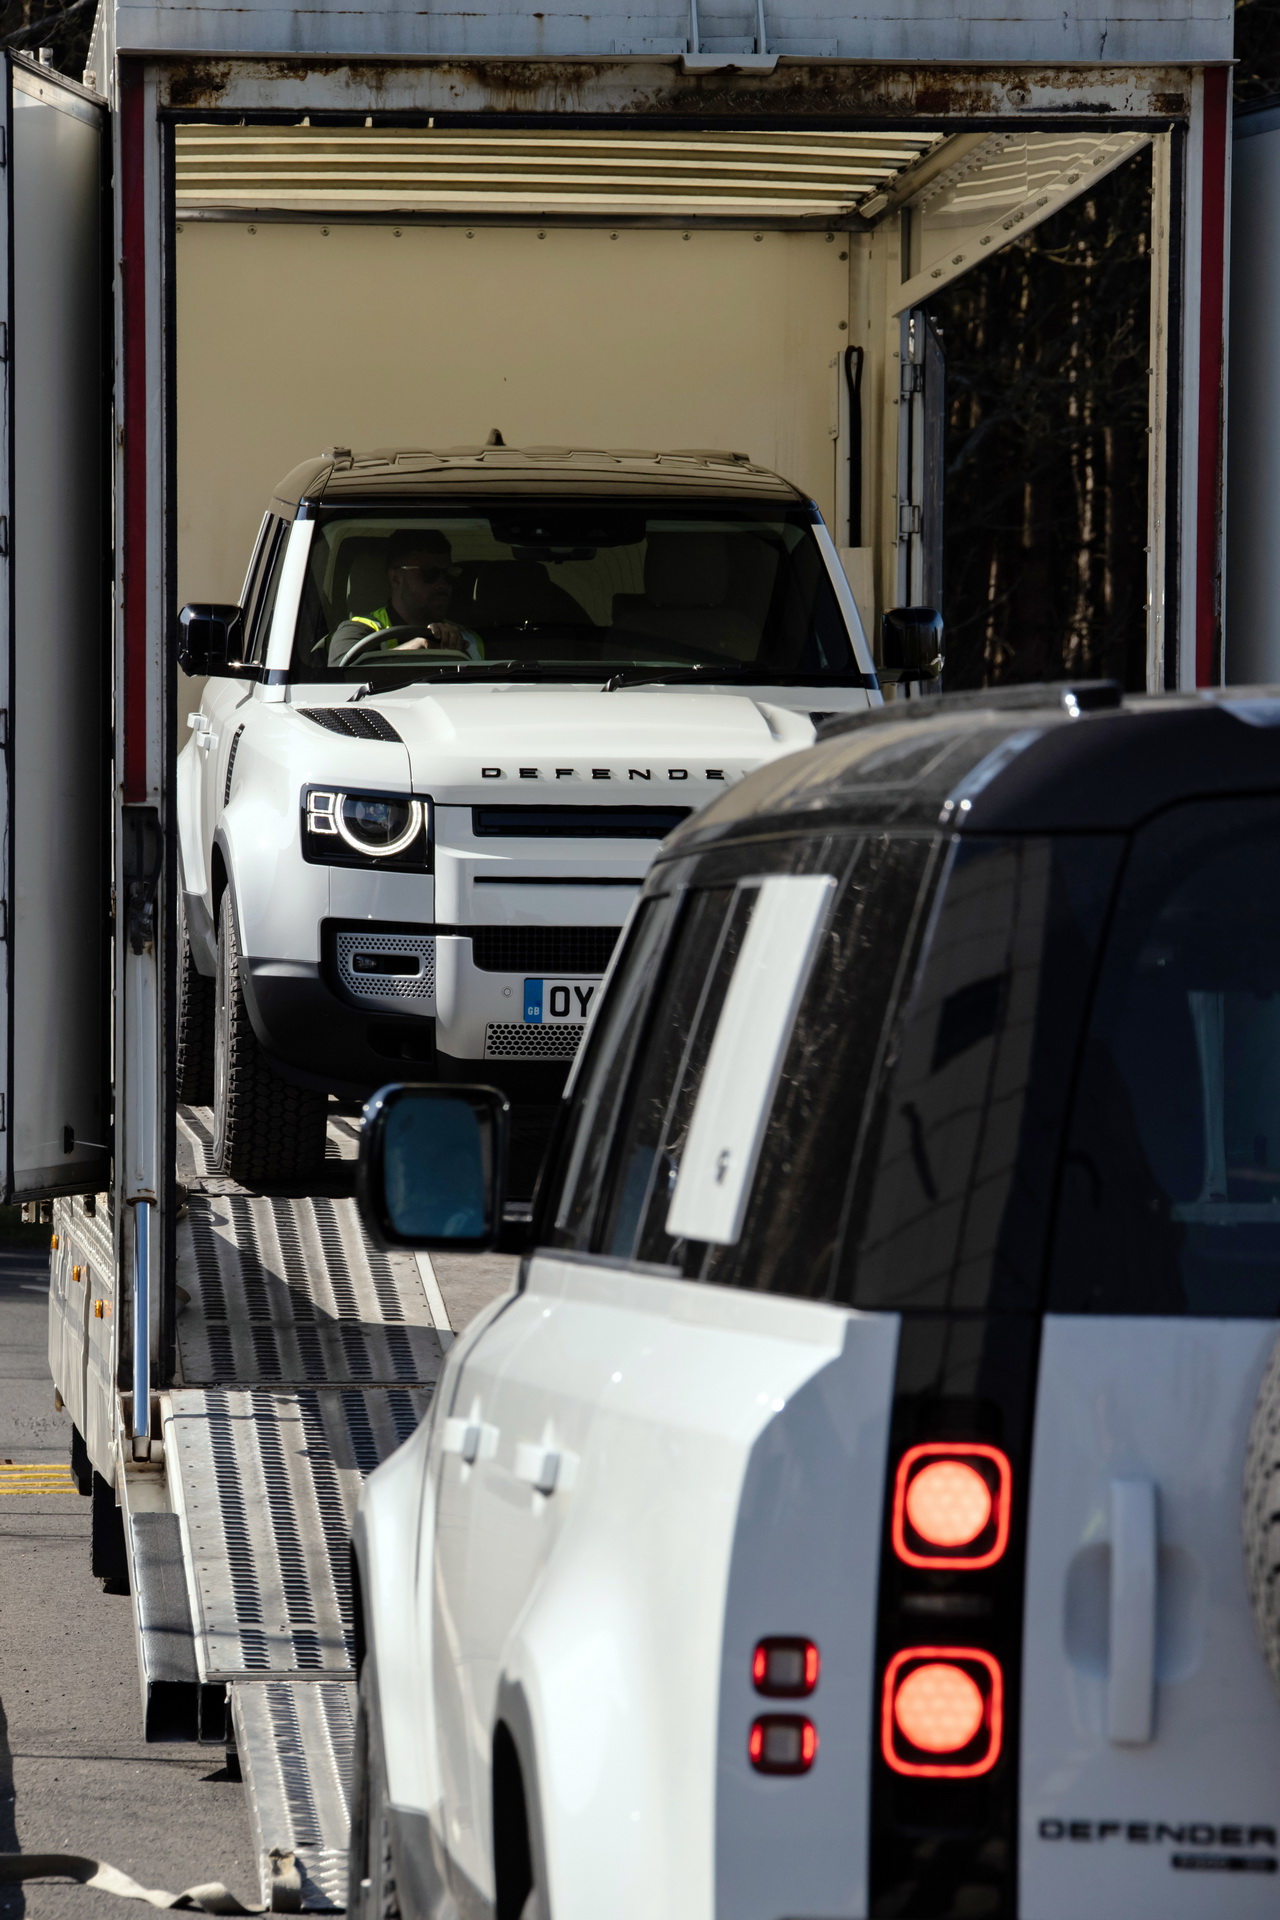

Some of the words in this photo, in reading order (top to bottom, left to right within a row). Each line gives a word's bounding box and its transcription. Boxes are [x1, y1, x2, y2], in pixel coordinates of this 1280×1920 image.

[481, 767, 725, 781] DEFENDE
[527, 1006, 540, 1016] GB
[550, 985, 595, 1018] OY
[1039, 1818, 1277, 1847] DEFENDER
